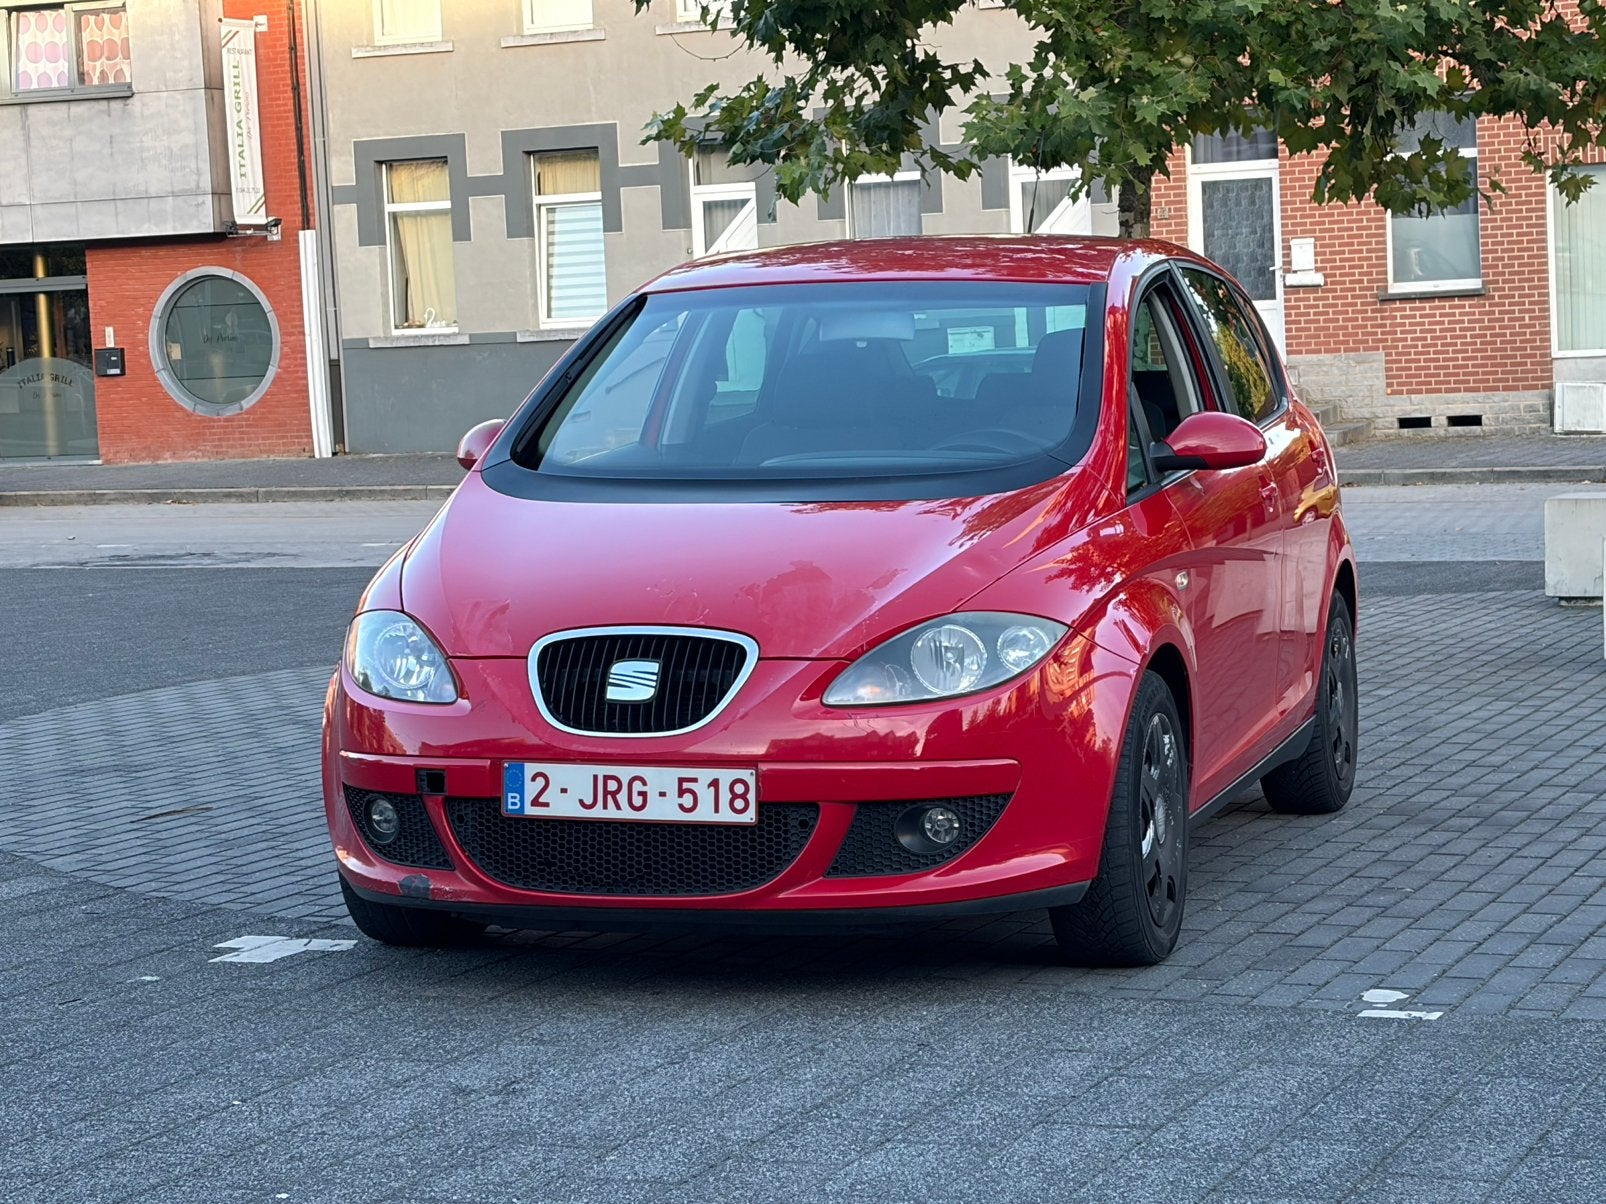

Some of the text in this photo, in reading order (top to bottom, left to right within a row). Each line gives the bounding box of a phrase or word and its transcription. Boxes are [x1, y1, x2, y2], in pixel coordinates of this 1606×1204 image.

[232, 60, 247, 179] ITALIA GRILL
[49, 373, 73, 387] GRILL
[507, 792, 521, 810] B
[530, 771, 751, 815] 2-JRG-518
